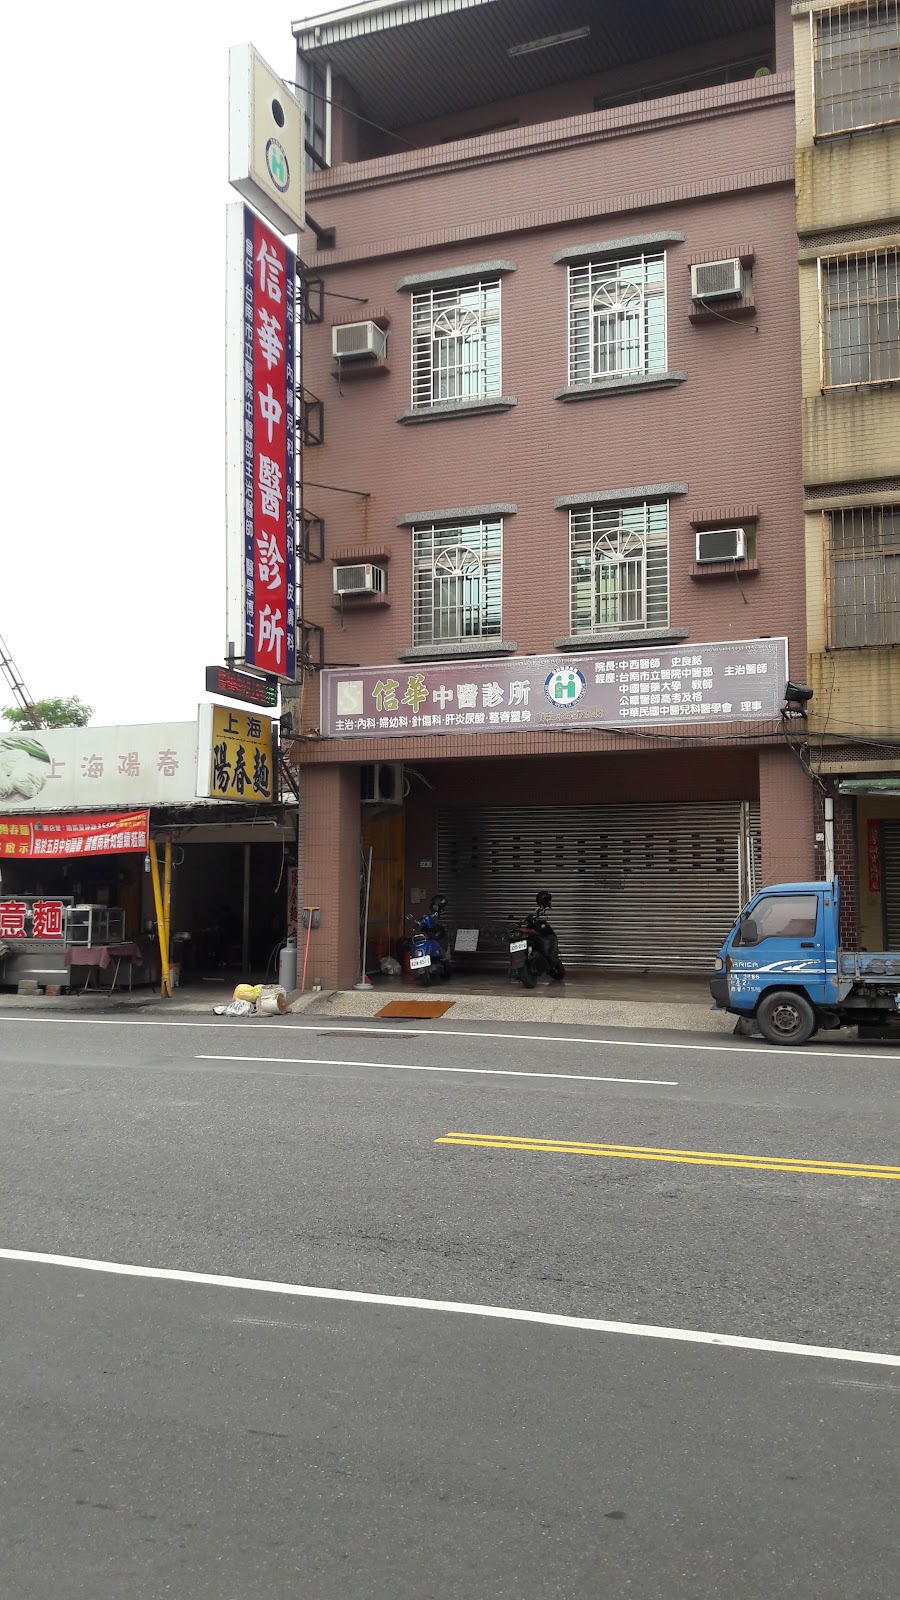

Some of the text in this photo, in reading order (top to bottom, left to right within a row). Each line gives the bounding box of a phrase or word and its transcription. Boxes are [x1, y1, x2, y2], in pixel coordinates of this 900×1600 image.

[256, 238, 285, 665] 信華中醫診所
[671, 655, 703, 668] 史良銘
[723, 663, 768, 677] 主治醫師
[619, 681, 682, 694] 中國醫藥大學
[619, 692, 703, 707] 公職醫師高考及格
[619, 701, 763, 718] 中華民國中醫兒科醫學會 理事
[223, 712, 262, 739] 上海
[46, 748, 198, 779] 上海陽春
[213, 741, 271, 799] 陽春麵
